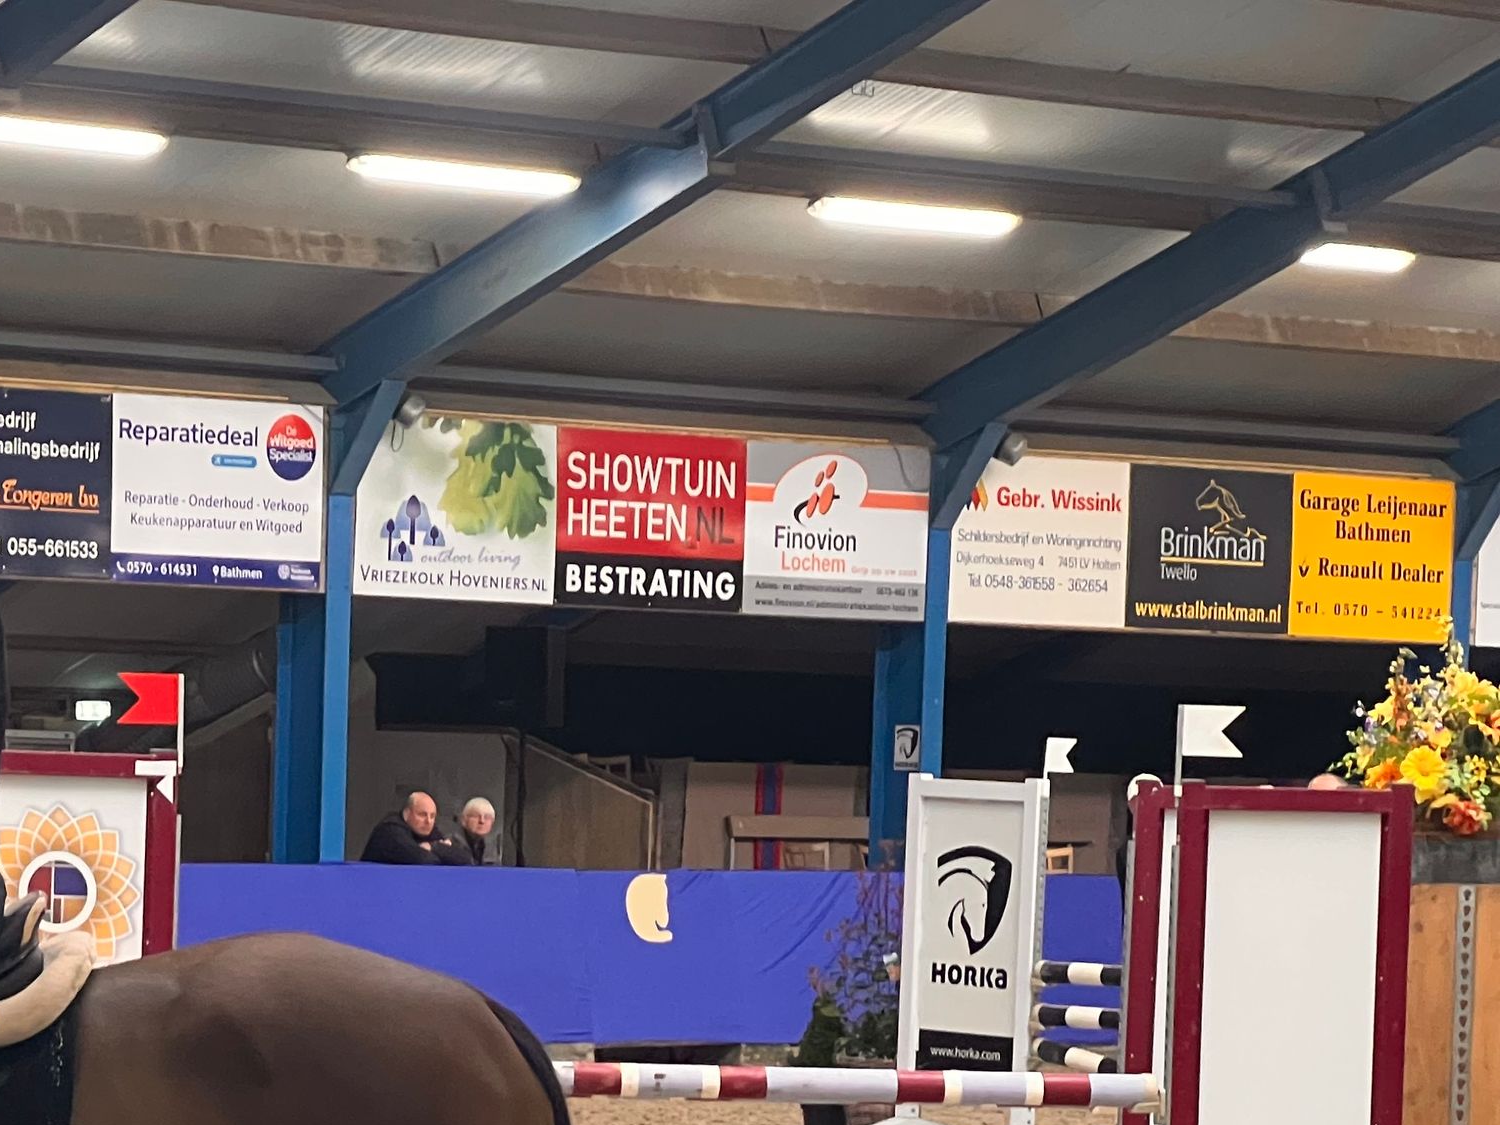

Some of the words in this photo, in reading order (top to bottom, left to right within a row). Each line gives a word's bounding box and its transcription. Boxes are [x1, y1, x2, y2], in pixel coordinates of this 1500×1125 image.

[119, 418, 259, 447] Reparatiedeal
[269, 433, 314, 450] Witgoed
[566, 451, 737, 499] SHOWTUIN
[124, 490, 179, 506] Reparatie
[188, 494, 254, 510] Onderhoud
[262, 499, 309, 516] Verkoop
[997, 486, 1044, 508] Gebr.
[1051, 489, 1122, 512] Wissink
[1300, 489, 1360, 517] Garage
[1367, 494, 1447, 521] Leijenaar
[130, 512, 237, 531] Keukenapparatuur
[239, 520, 253, 531] en
[256, 519, 303, 536] Witgoed
[1336, 520, 1411, 543] Bathmen
[7, 537, 98, 559] 055-661533
[774, 525, 857, 552] Finovion
[957, 528, 1028, 548] Schildersbedrijf
[1032, 535, 1043, 545] en
[1160, 525, 1266, 561] Brinkman
[127, 561, 153, 575] 0570
[220, 565, 263, 579] Bathmen
[781, 551, 846, 573] Lochem
[1038, 556, 1044, 566] 4
[1160, 562, 1197, 581] Twello
[1318, 557, 1383, 580] Renault
[1391, 562, 1444, 584] Dealer
[360, 564, 445, 586] VRIEZEKOLK
[565, 563, 736, 601] BESTRATING
[1135, 600, 1282, 624] www.stalbrinkman.nl
[1296, 601, 1325, 615] Tel.
[1334, 603, 1368, 617] 0570
[930, 1045, 1001, 1062] www.horka.com
